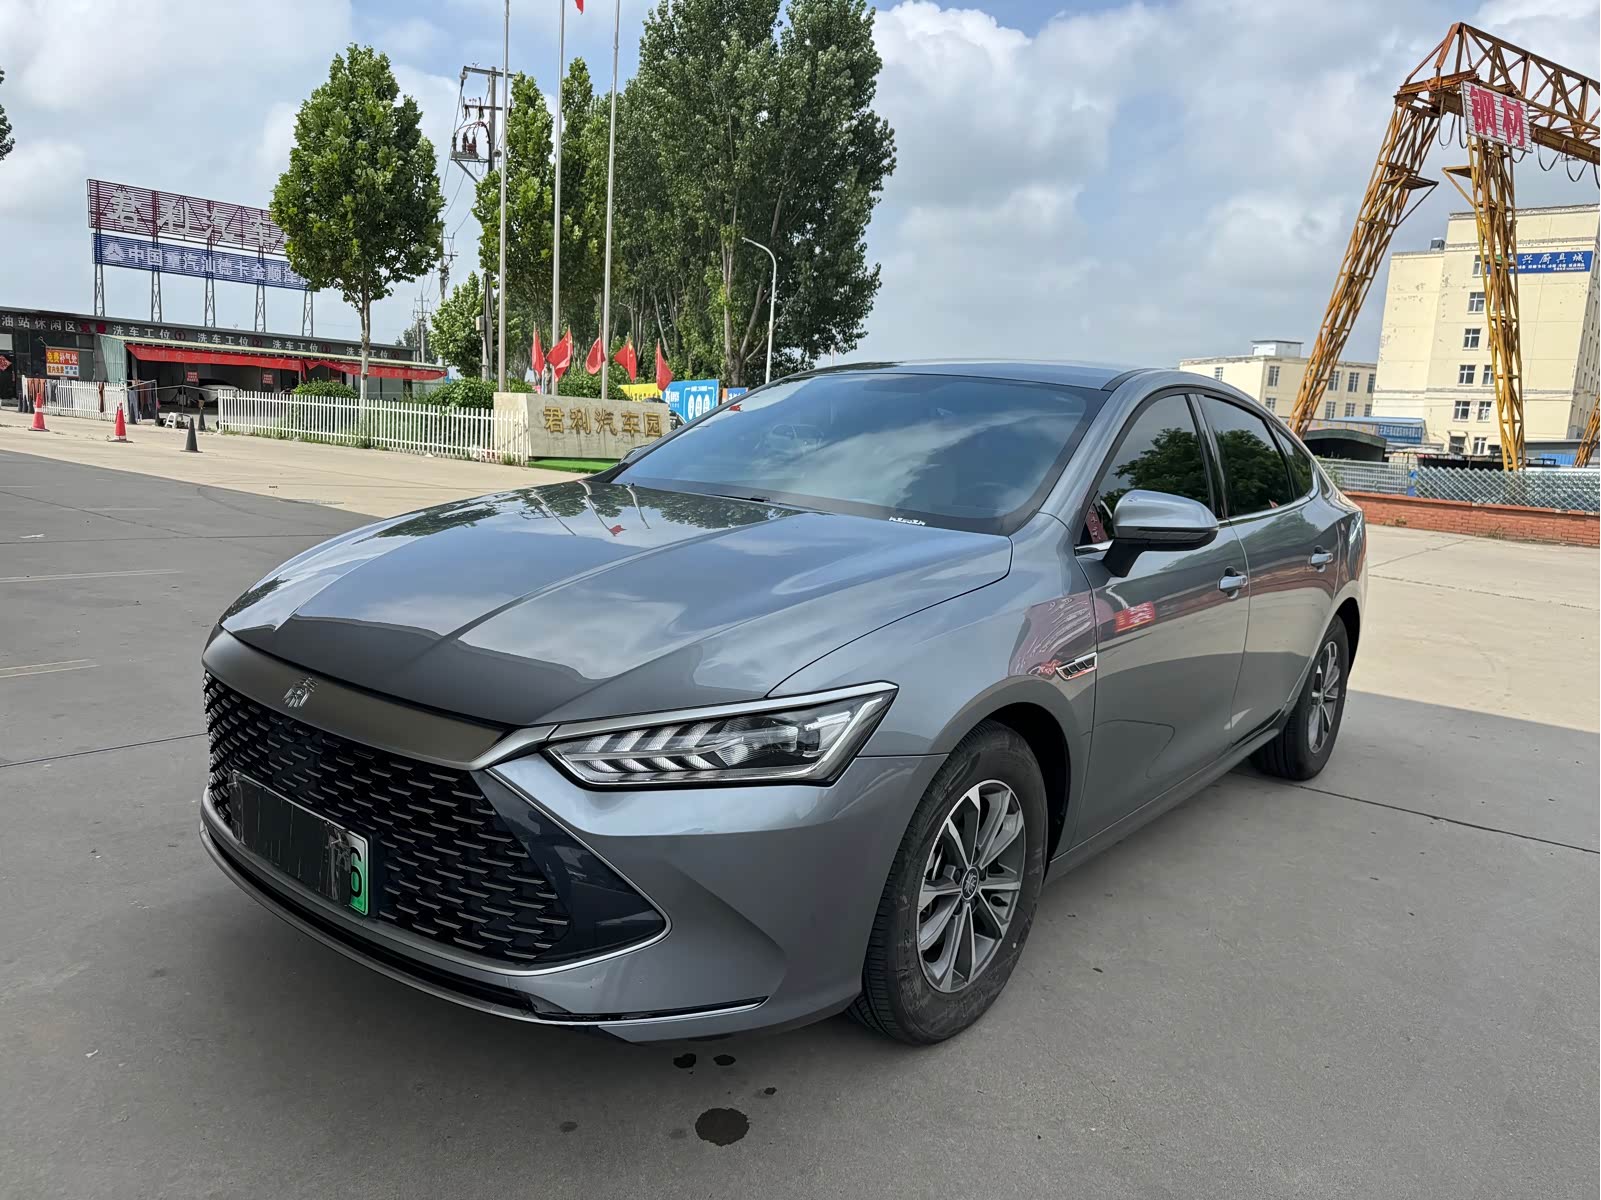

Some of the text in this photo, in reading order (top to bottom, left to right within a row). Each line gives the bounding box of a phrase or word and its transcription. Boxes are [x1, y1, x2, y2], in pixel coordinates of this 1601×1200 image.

[1470, 85, 1526, 148] 钢材
[105, 189, 290, 246] 君利汽车
[1, 314, 76, 332] 油站休闲区
[112, 325, 170, 340] 洗车工位
[197, 332, 249, 347] 洗车工位
[272, 339, 319, 352] 洗车工位
[47, 351, 78, 364] 免费补气处
[543, 405, 663, 437] 君利汽车园
[351, 846, 363, 898] 6
